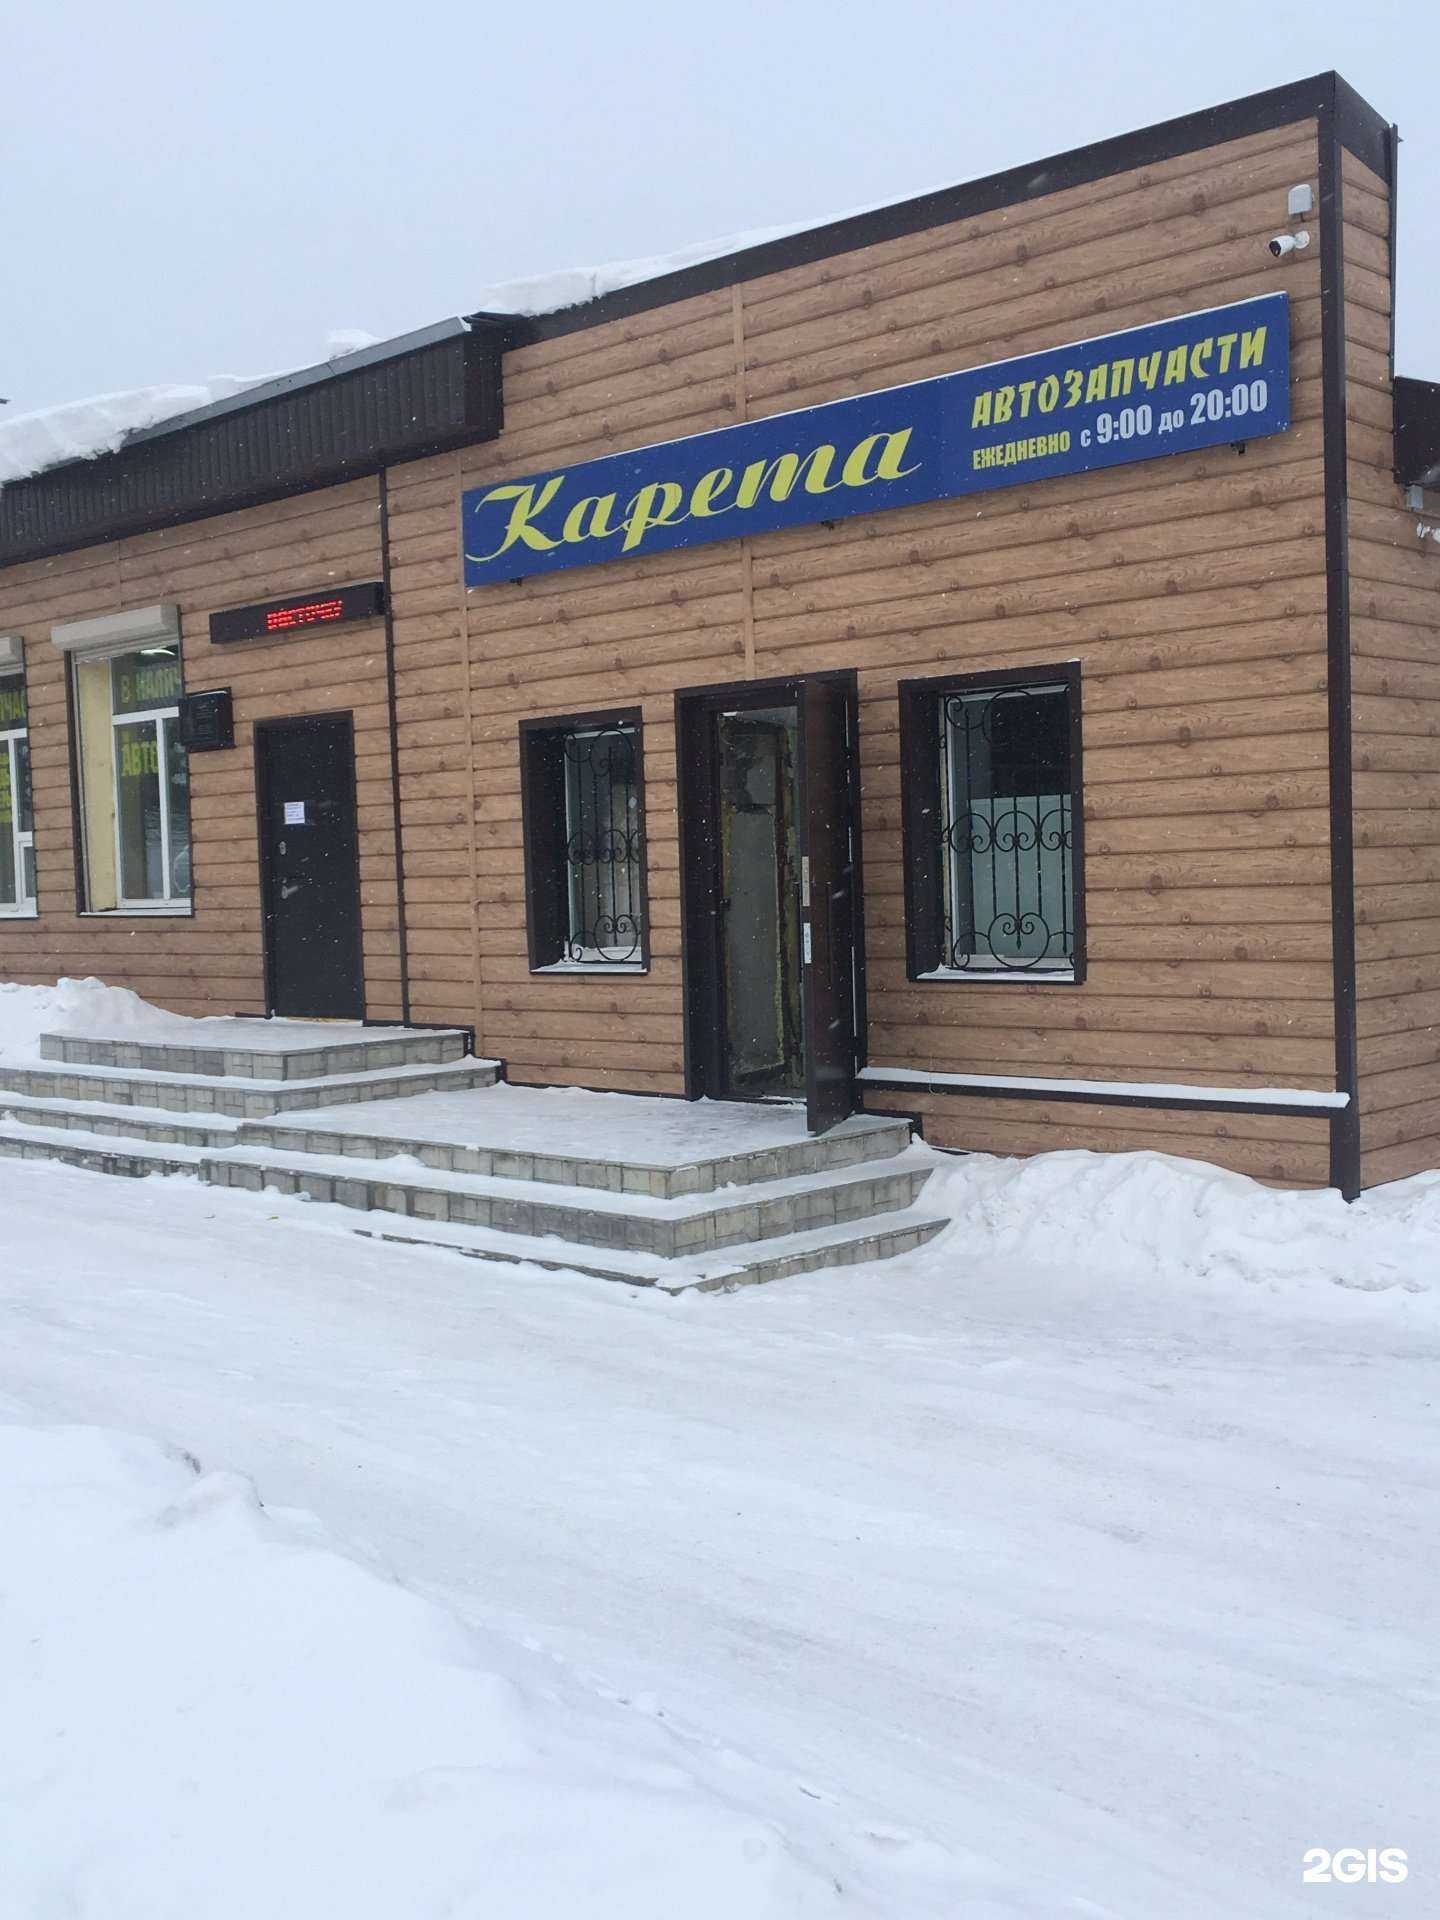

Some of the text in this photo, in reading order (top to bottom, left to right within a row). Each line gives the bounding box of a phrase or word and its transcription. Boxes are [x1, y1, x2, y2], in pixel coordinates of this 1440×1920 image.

[971, 326, 1268, 429] АВТОЗАПЧАСТИ
[972, 431, 1071, 470] ЕЖЕДНЕВНО
[1096, 405, 1152, 444] 9:00
[1158, 409, 1184, 434] до
[1190, 380, 1268, 425] 20:00
[466, 427, 923, 562] Карета
